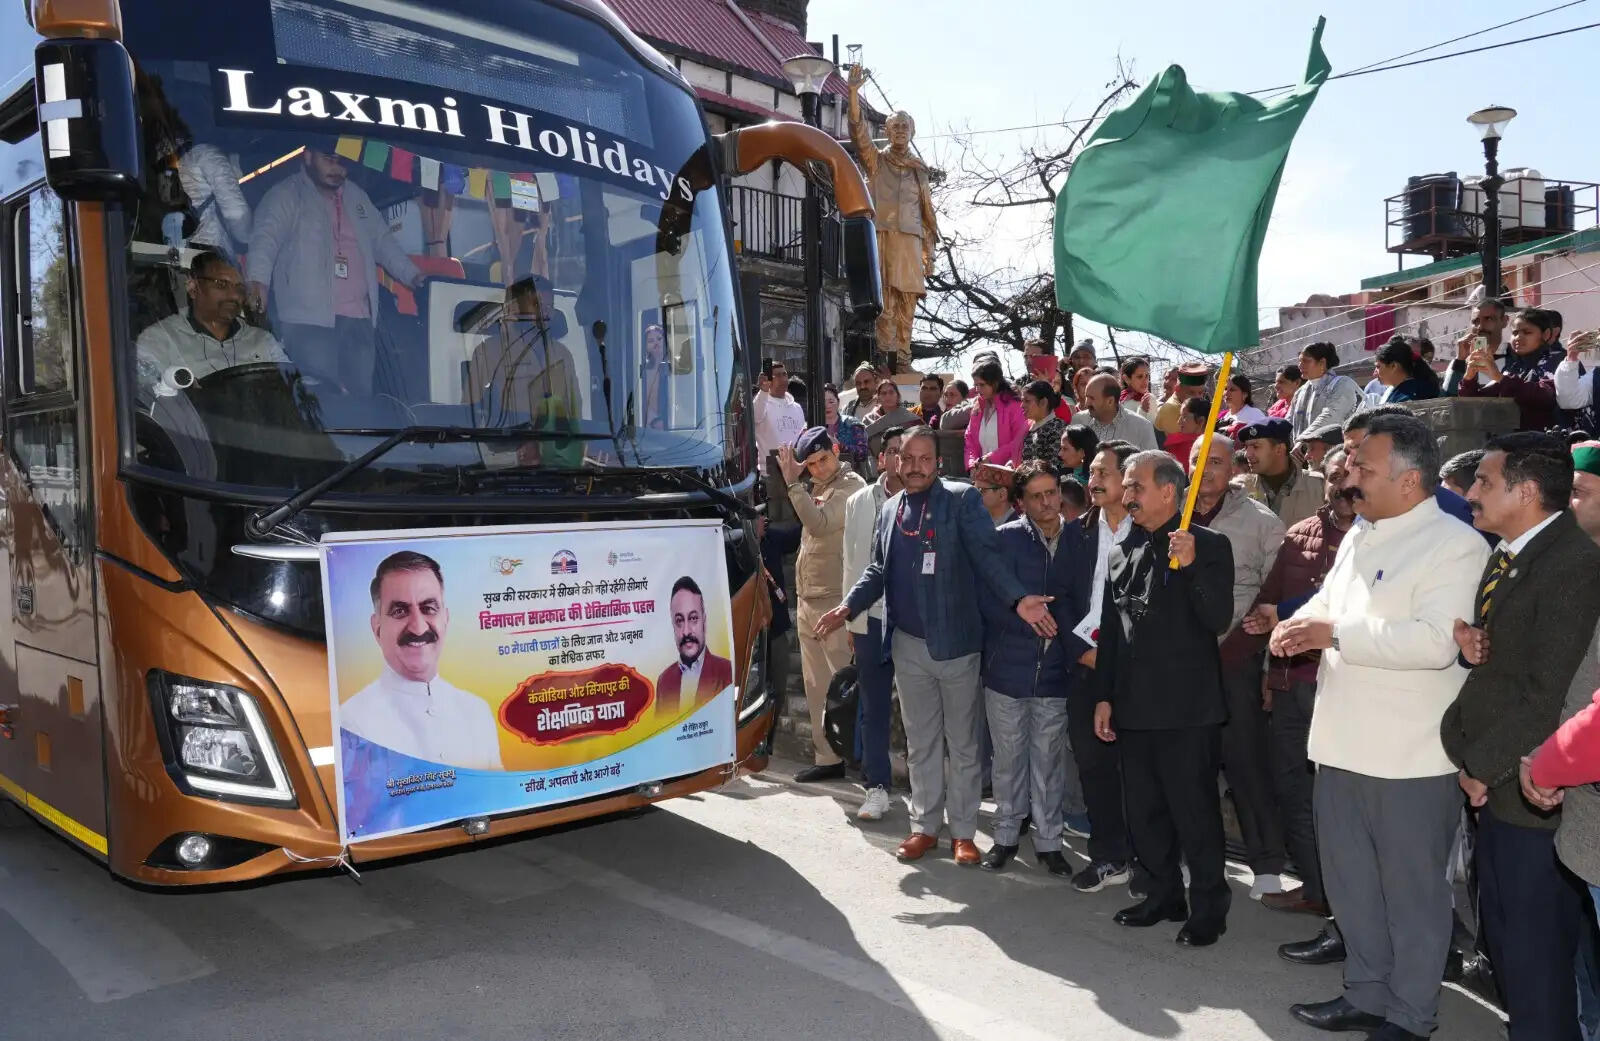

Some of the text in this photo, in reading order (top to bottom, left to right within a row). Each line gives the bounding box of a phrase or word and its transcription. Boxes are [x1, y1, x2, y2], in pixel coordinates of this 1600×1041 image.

[217, 67, 694, 202] Laxmi Holidays
[484, 591, 501, 608] सुख
[503, 587, 515, 603] की
[518, 590, 547, 601] सरकार
[557, 583, 580, 598] सीखने
[582, 581, 593, 595] की
[595, 579, 609, 594] नहीं
[609, 578, 626, 595] रहेंगी
[479, 599, 655, 630] हिमाचल सरकार की ऐतिहासिक पहल
[498, 629, 643, 656] 50 मेधावी छात्रों के लिए ज्ञान और अनुभव
[548, 649, 605, 666] का वैश्विक सफर
[528, 687, 566, 704] कंबोडिया
[586, 680, 618, 697] सिंगापुर
[619, 676, 630, 691] की
[537, 701, 625, 731] शैक्षणिक यात्रा
[580, 768, 592, 782] और
[595, 765, 609, 779] आगे
